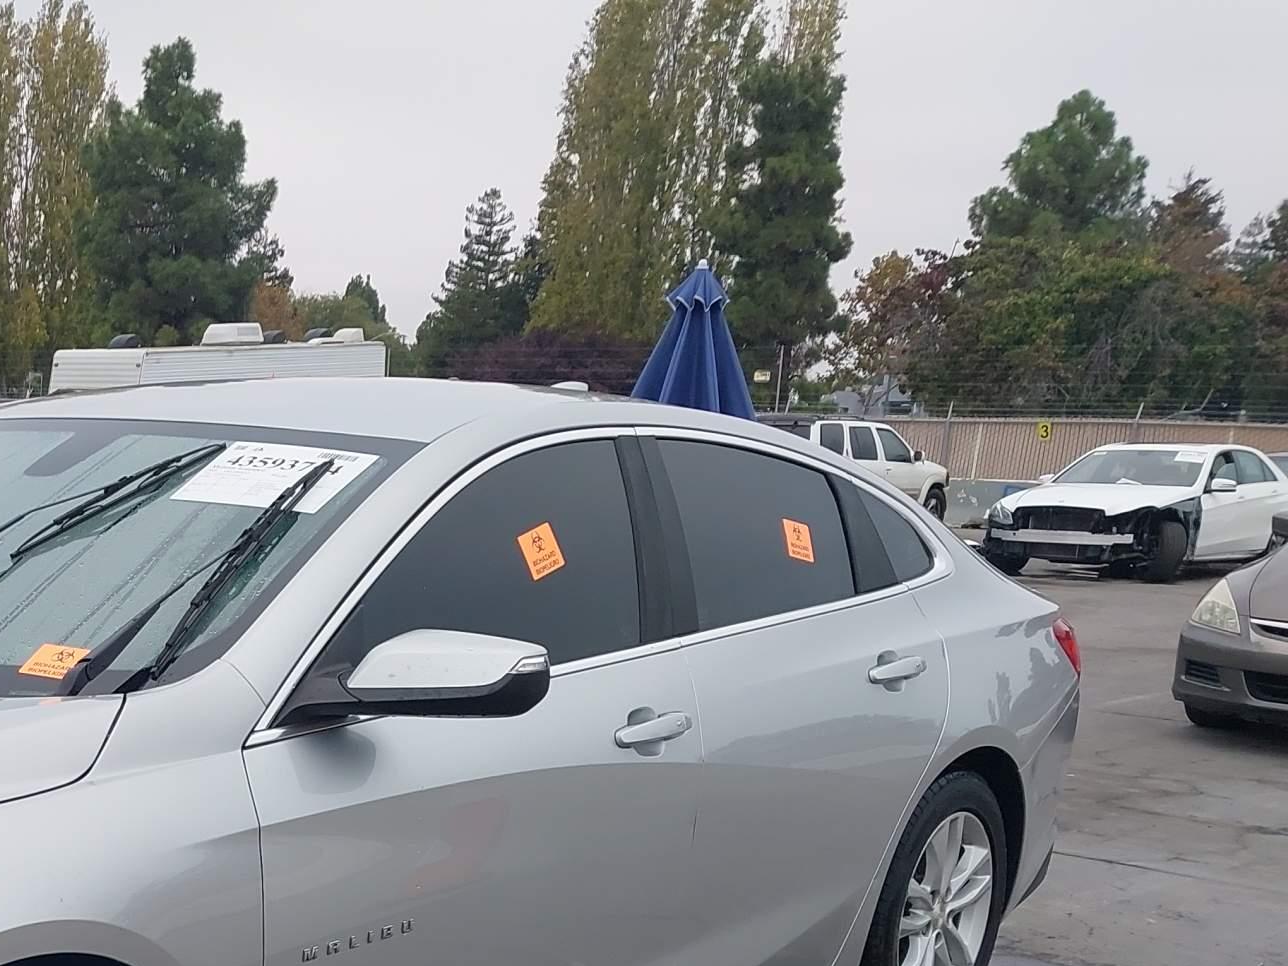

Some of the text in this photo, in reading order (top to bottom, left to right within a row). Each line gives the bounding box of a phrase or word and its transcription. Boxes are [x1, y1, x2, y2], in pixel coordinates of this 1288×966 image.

[1041, 424, 1049, 438] 3
[226, 455, 344, 475] 4359374
[301, 918, 415, 963] MALIBU
